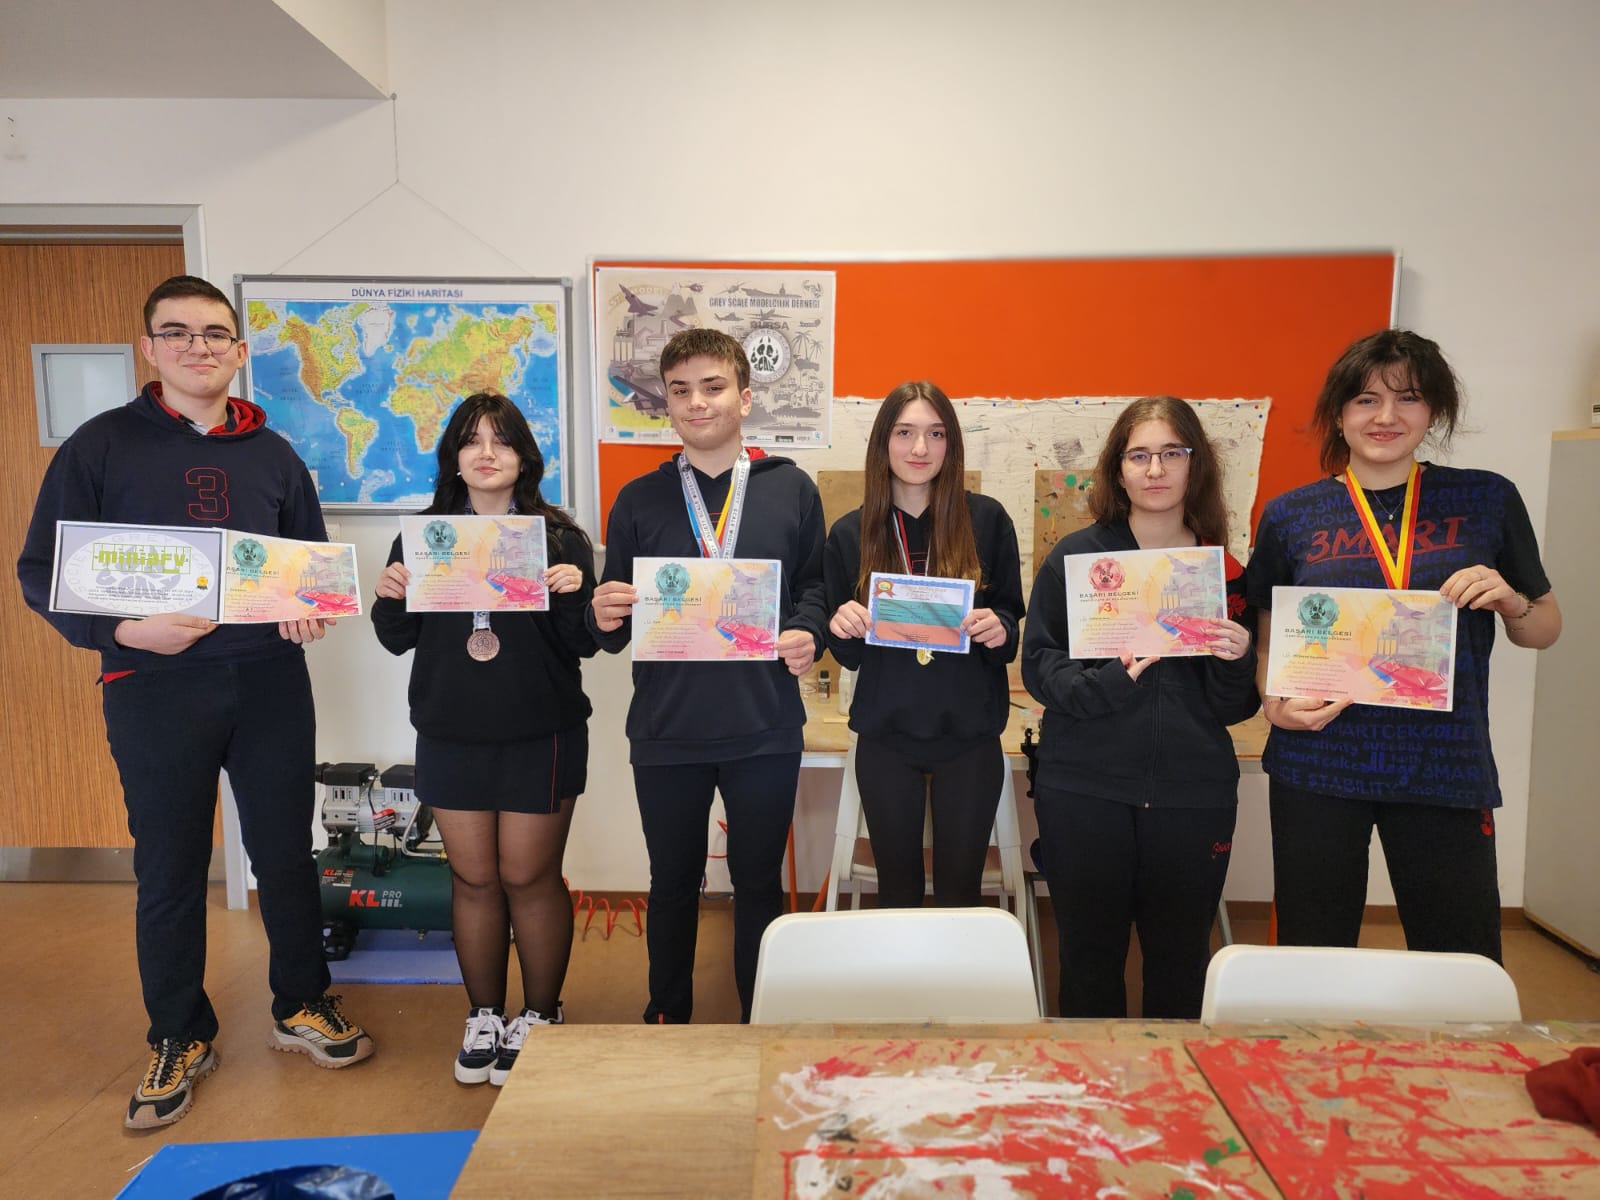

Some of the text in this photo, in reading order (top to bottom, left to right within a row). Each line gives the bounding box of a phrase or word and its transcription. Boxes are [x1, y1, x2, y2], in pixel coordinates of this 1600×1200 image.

[351, 287, 385, 297] DÜNYA
[708, 297, 726, 307] GREY
[728, 298, 748, 308] SCALE
[750, 320, 790, 331] BURSA
[185, 467, 230, 521] 3
[1103, 602, 1113, 613] 3
[348, 889, 403, 908] KL PRO
